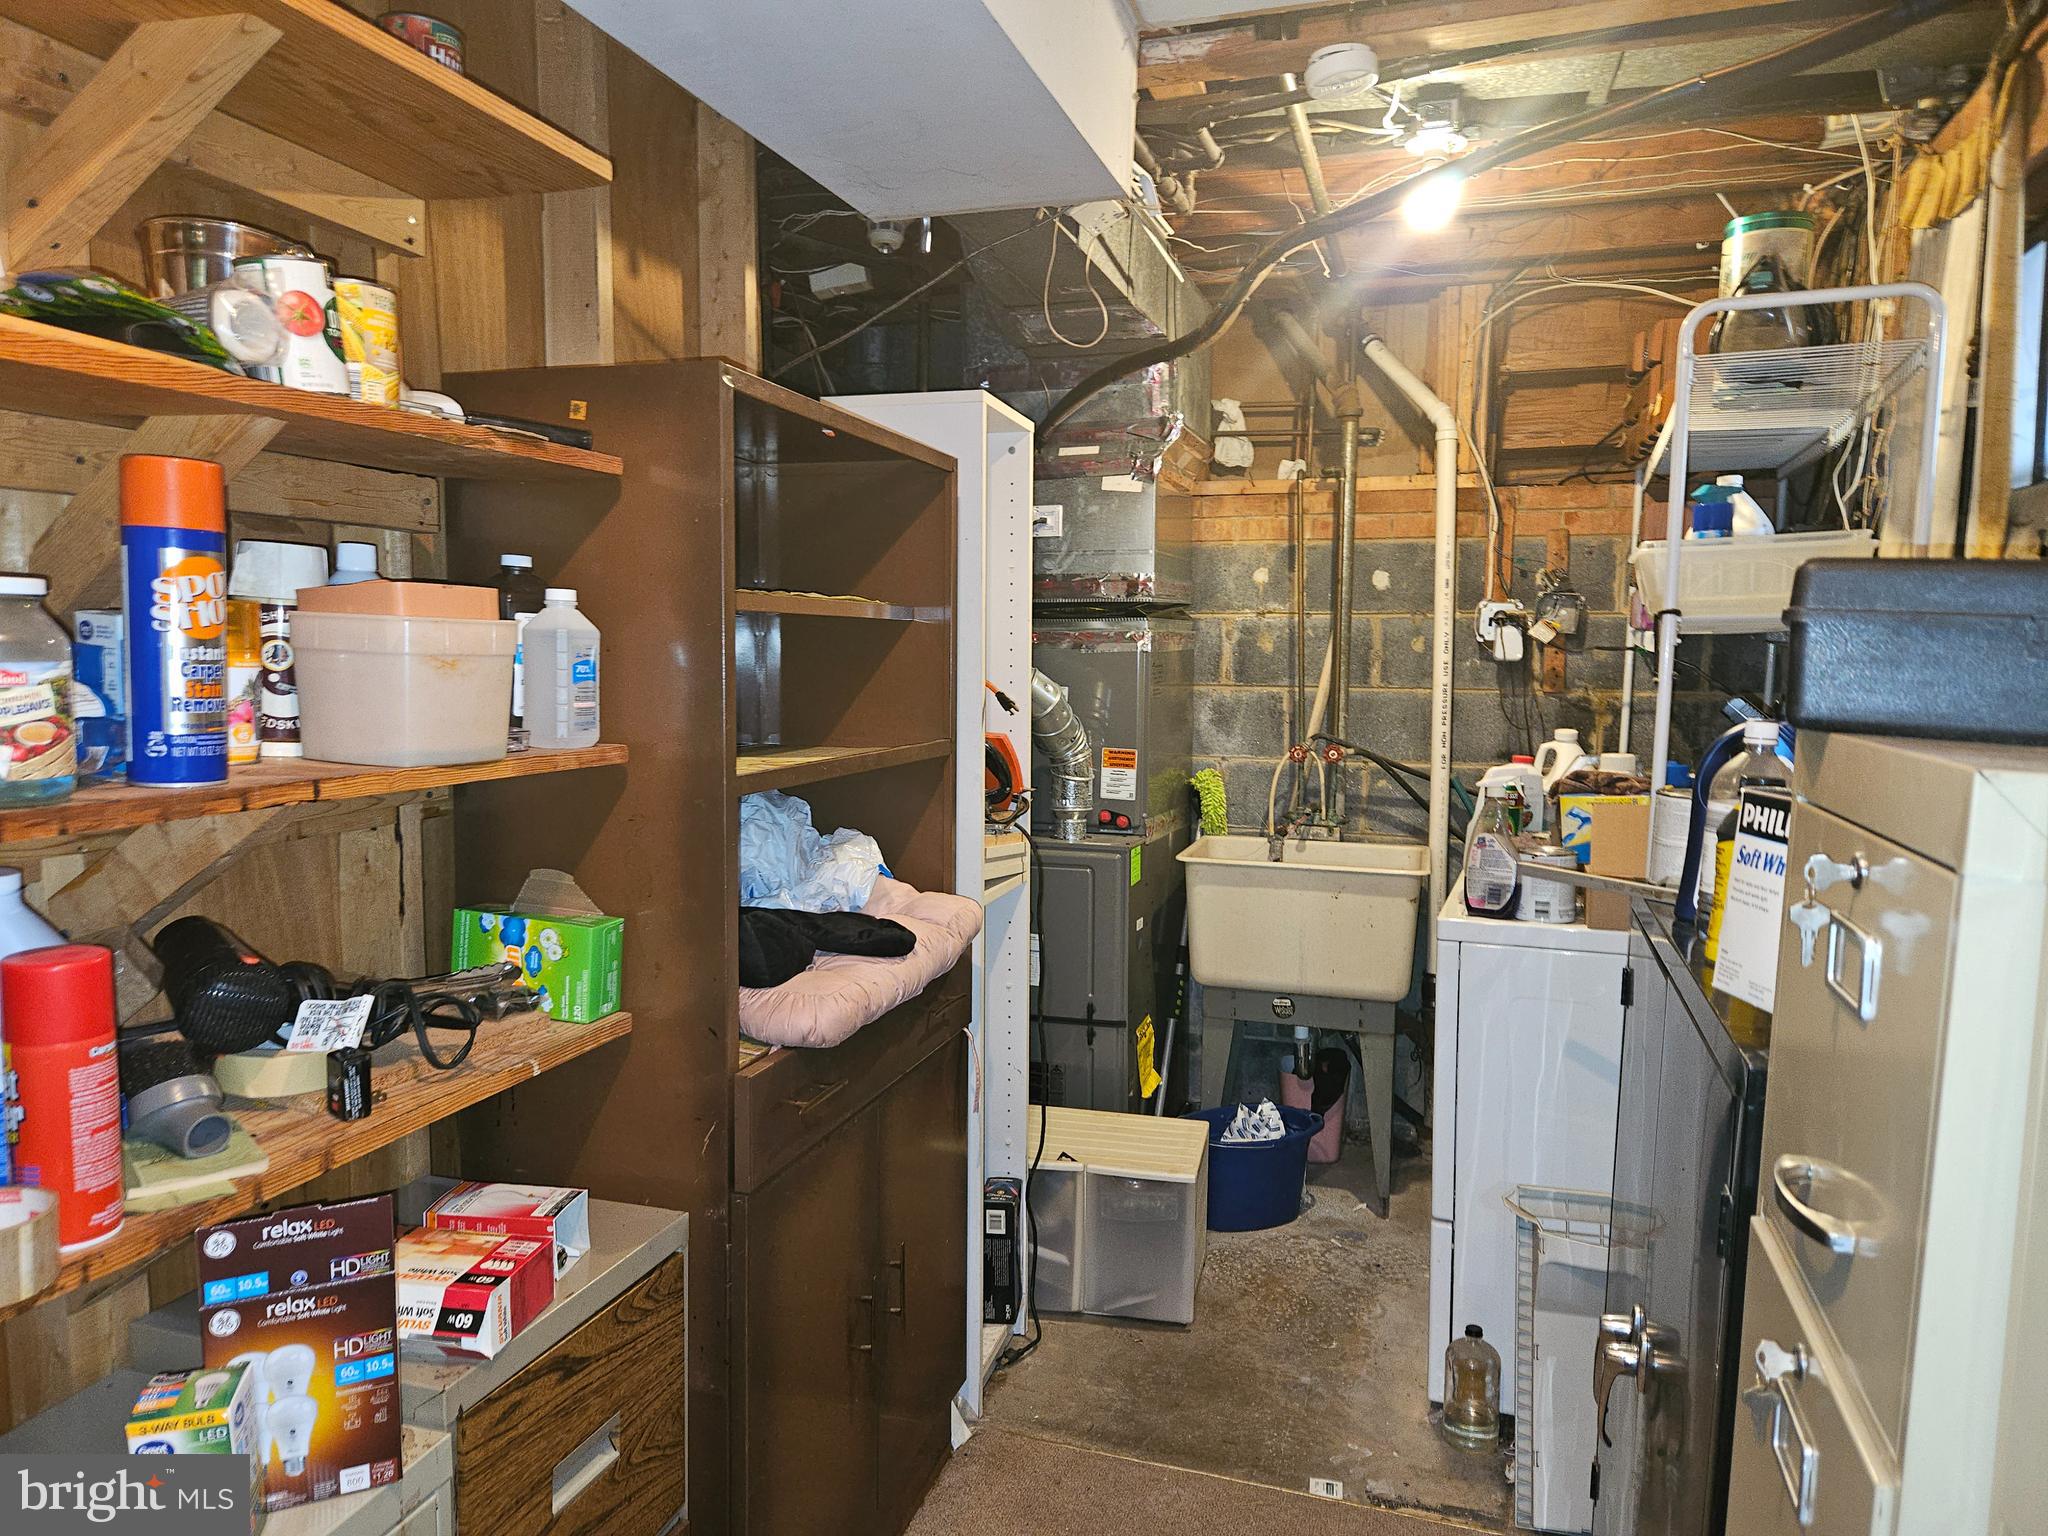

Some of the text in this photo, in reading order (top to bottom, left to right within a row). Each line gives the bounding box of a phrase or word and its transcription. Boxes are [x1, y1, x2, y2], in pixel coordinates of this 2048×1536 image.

[185, 680, 224, 698] Stain
[1441, 683, 1449, 726] PRESSURE
[1737, 844, 1761, 870] Soft
[262, 1217, 336, 1241] relax LED
[330, 1251, 391, 1280] HD LIGHT
[266, 1295, 339, 1319] relax LED
[416, 1306, 436, 1318] Soft
[333, 1329, 393, 1360] HD LIGHT
[138, 1420, 179, 1436] 3-WAY
[199, 1427, 228, 1442] LED
